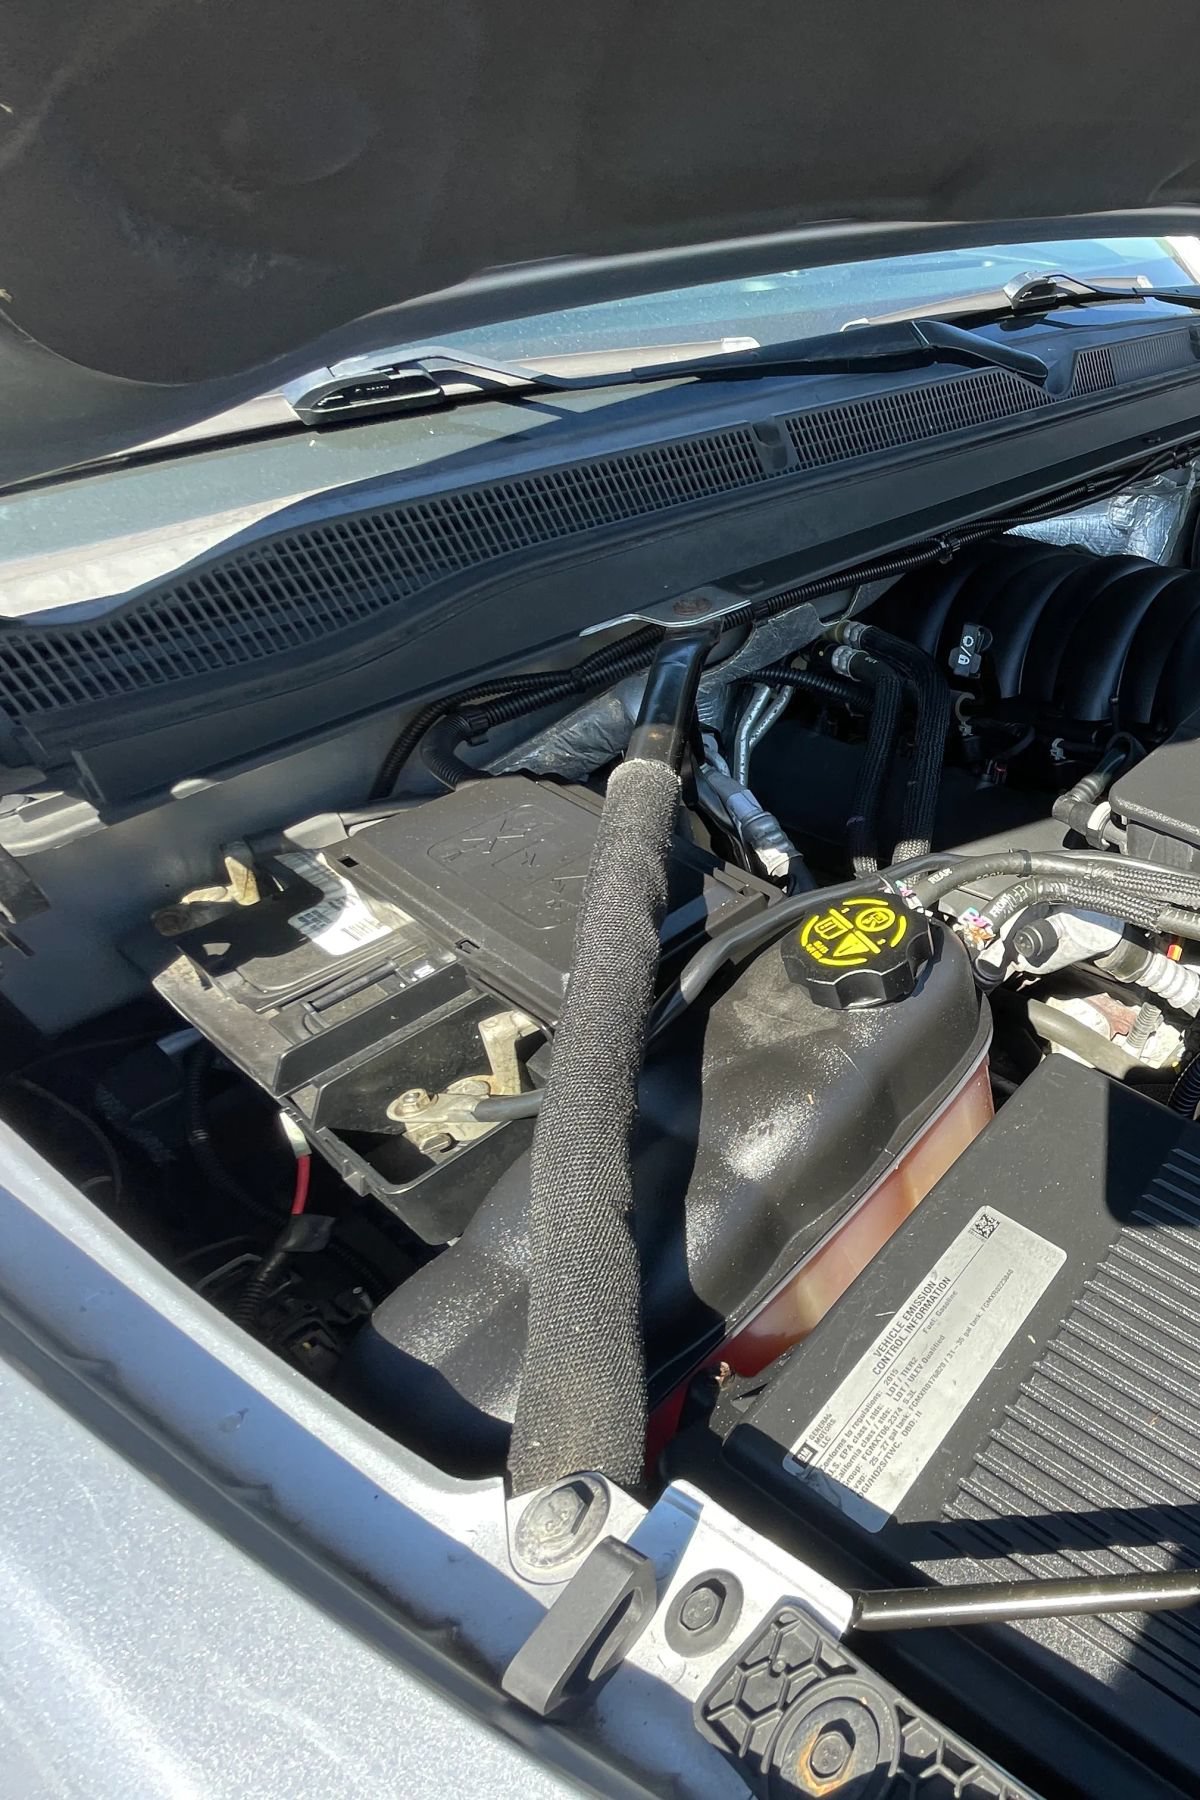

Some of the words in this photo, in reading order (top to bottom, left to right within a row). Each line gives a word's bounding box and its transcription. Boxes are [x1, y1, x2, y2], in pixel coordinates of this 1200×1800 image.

[928, 868, 952, 884] REAR
[872, 1335, 907, 1374] CONTROL
[904, 1276, 950, 1333] INFORMATION
[873, 1321, 904, 1356] VEHICLE
[902, 1280, 936, 1320] EMISSION
[935, 1290, 957, 1316] Gasoline
[819, 1438, 846, 1471] Conforms
[844, 1429, 853, 1437] to
[851, 1390, 882, 1429] regulations:
[883, 1368, 898, 1386] 2015
[835, 1448, 861, 1481] California
[860, 1429, 875, 1447] class
[877, 1407, 891, 1424] stds:
[892, 1386, 906, 1401] LDT
[906, 1363, 923, 1382] ULEV
[921, 1334, 945, 1363] Qualified
[839, 1444, 853, 1459] EPA
[852, 1425, 867, 1443] class
[869, 1403, 883, 1420] stds:
[885, 1381, 898, 1397] LDT
[900, 1356, 917, 1376] TIER2
[888, 1428, 898, 1441] gal
[963, 1326, 971, 1337] gal
[808, 1413, 832, 1440] GENERAL
[814, 1418, 836, 1444] MOTORS
[818, 1435, 831, 1448] LLC
